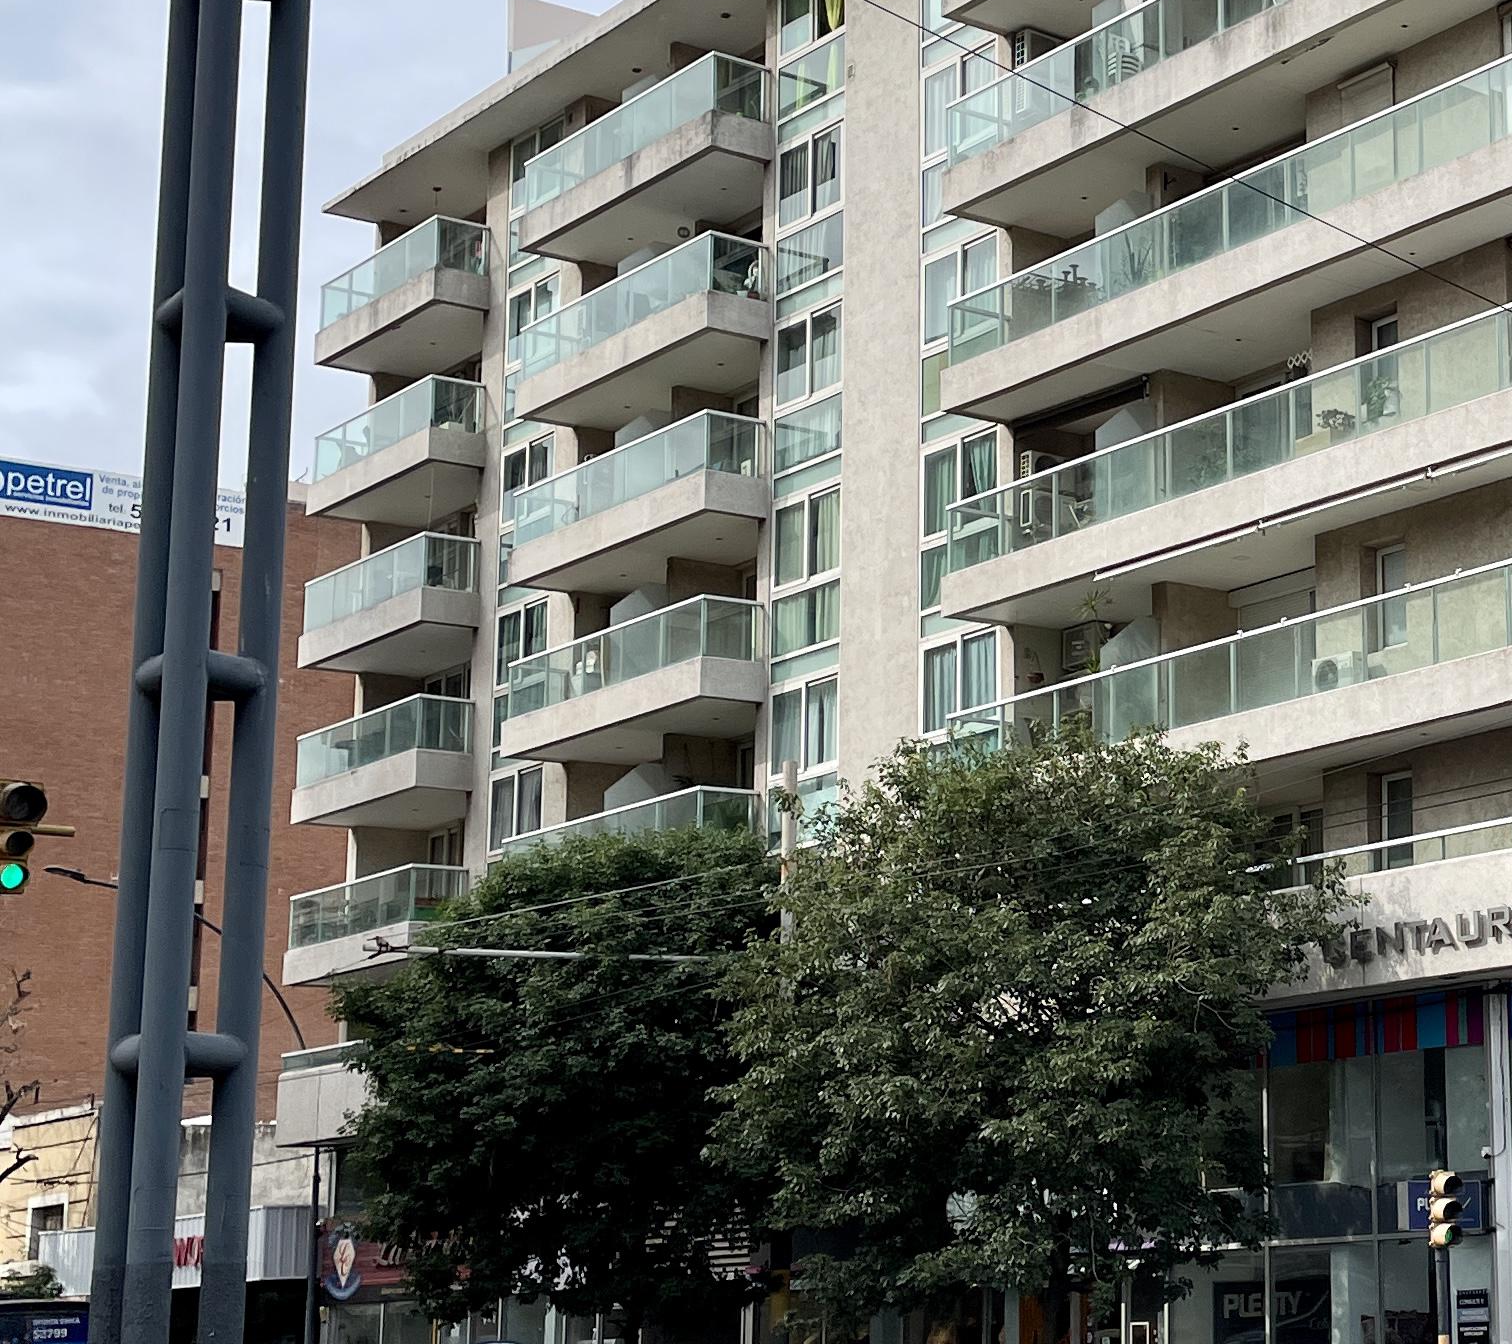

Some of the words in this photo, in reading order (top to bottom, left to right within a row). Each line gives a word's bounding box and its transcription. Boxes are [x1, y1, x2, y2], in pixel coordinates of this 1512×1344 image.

[117, 488, 141, 501] prop
[130, 504, 142, 519] 5
[174, 1236, 205, 1268] WO
